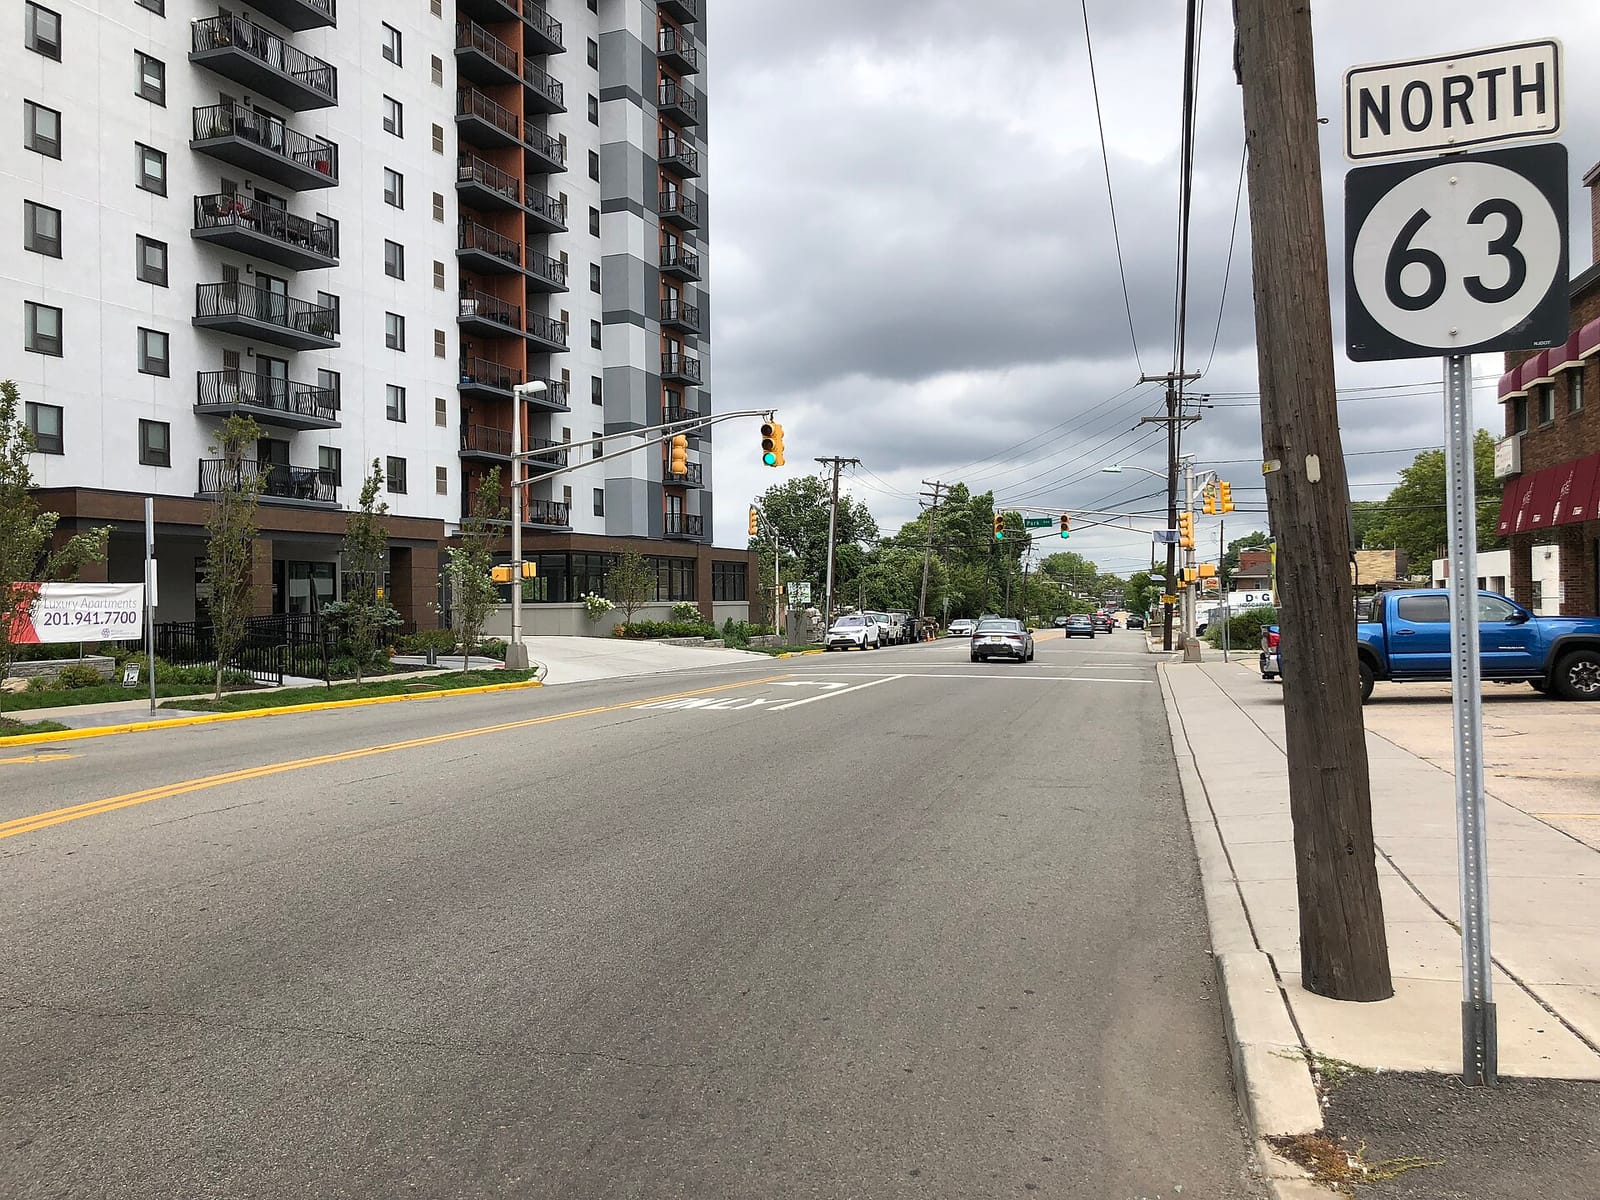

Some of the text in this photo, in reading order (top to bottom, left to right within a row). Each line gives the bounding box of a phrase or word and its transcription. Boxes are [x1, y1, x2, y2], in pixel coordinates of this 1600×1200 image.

[1359, 61, 1546, 138] NORTH
[1384, 197, 1527, 312] 63
[43, 597, 136, 610] Luxury Apartments
[1245, 594, 1254, 602] D
[1261, 593, 1270, 602] G
[43, 611, 137, 626] 201.941.7700
